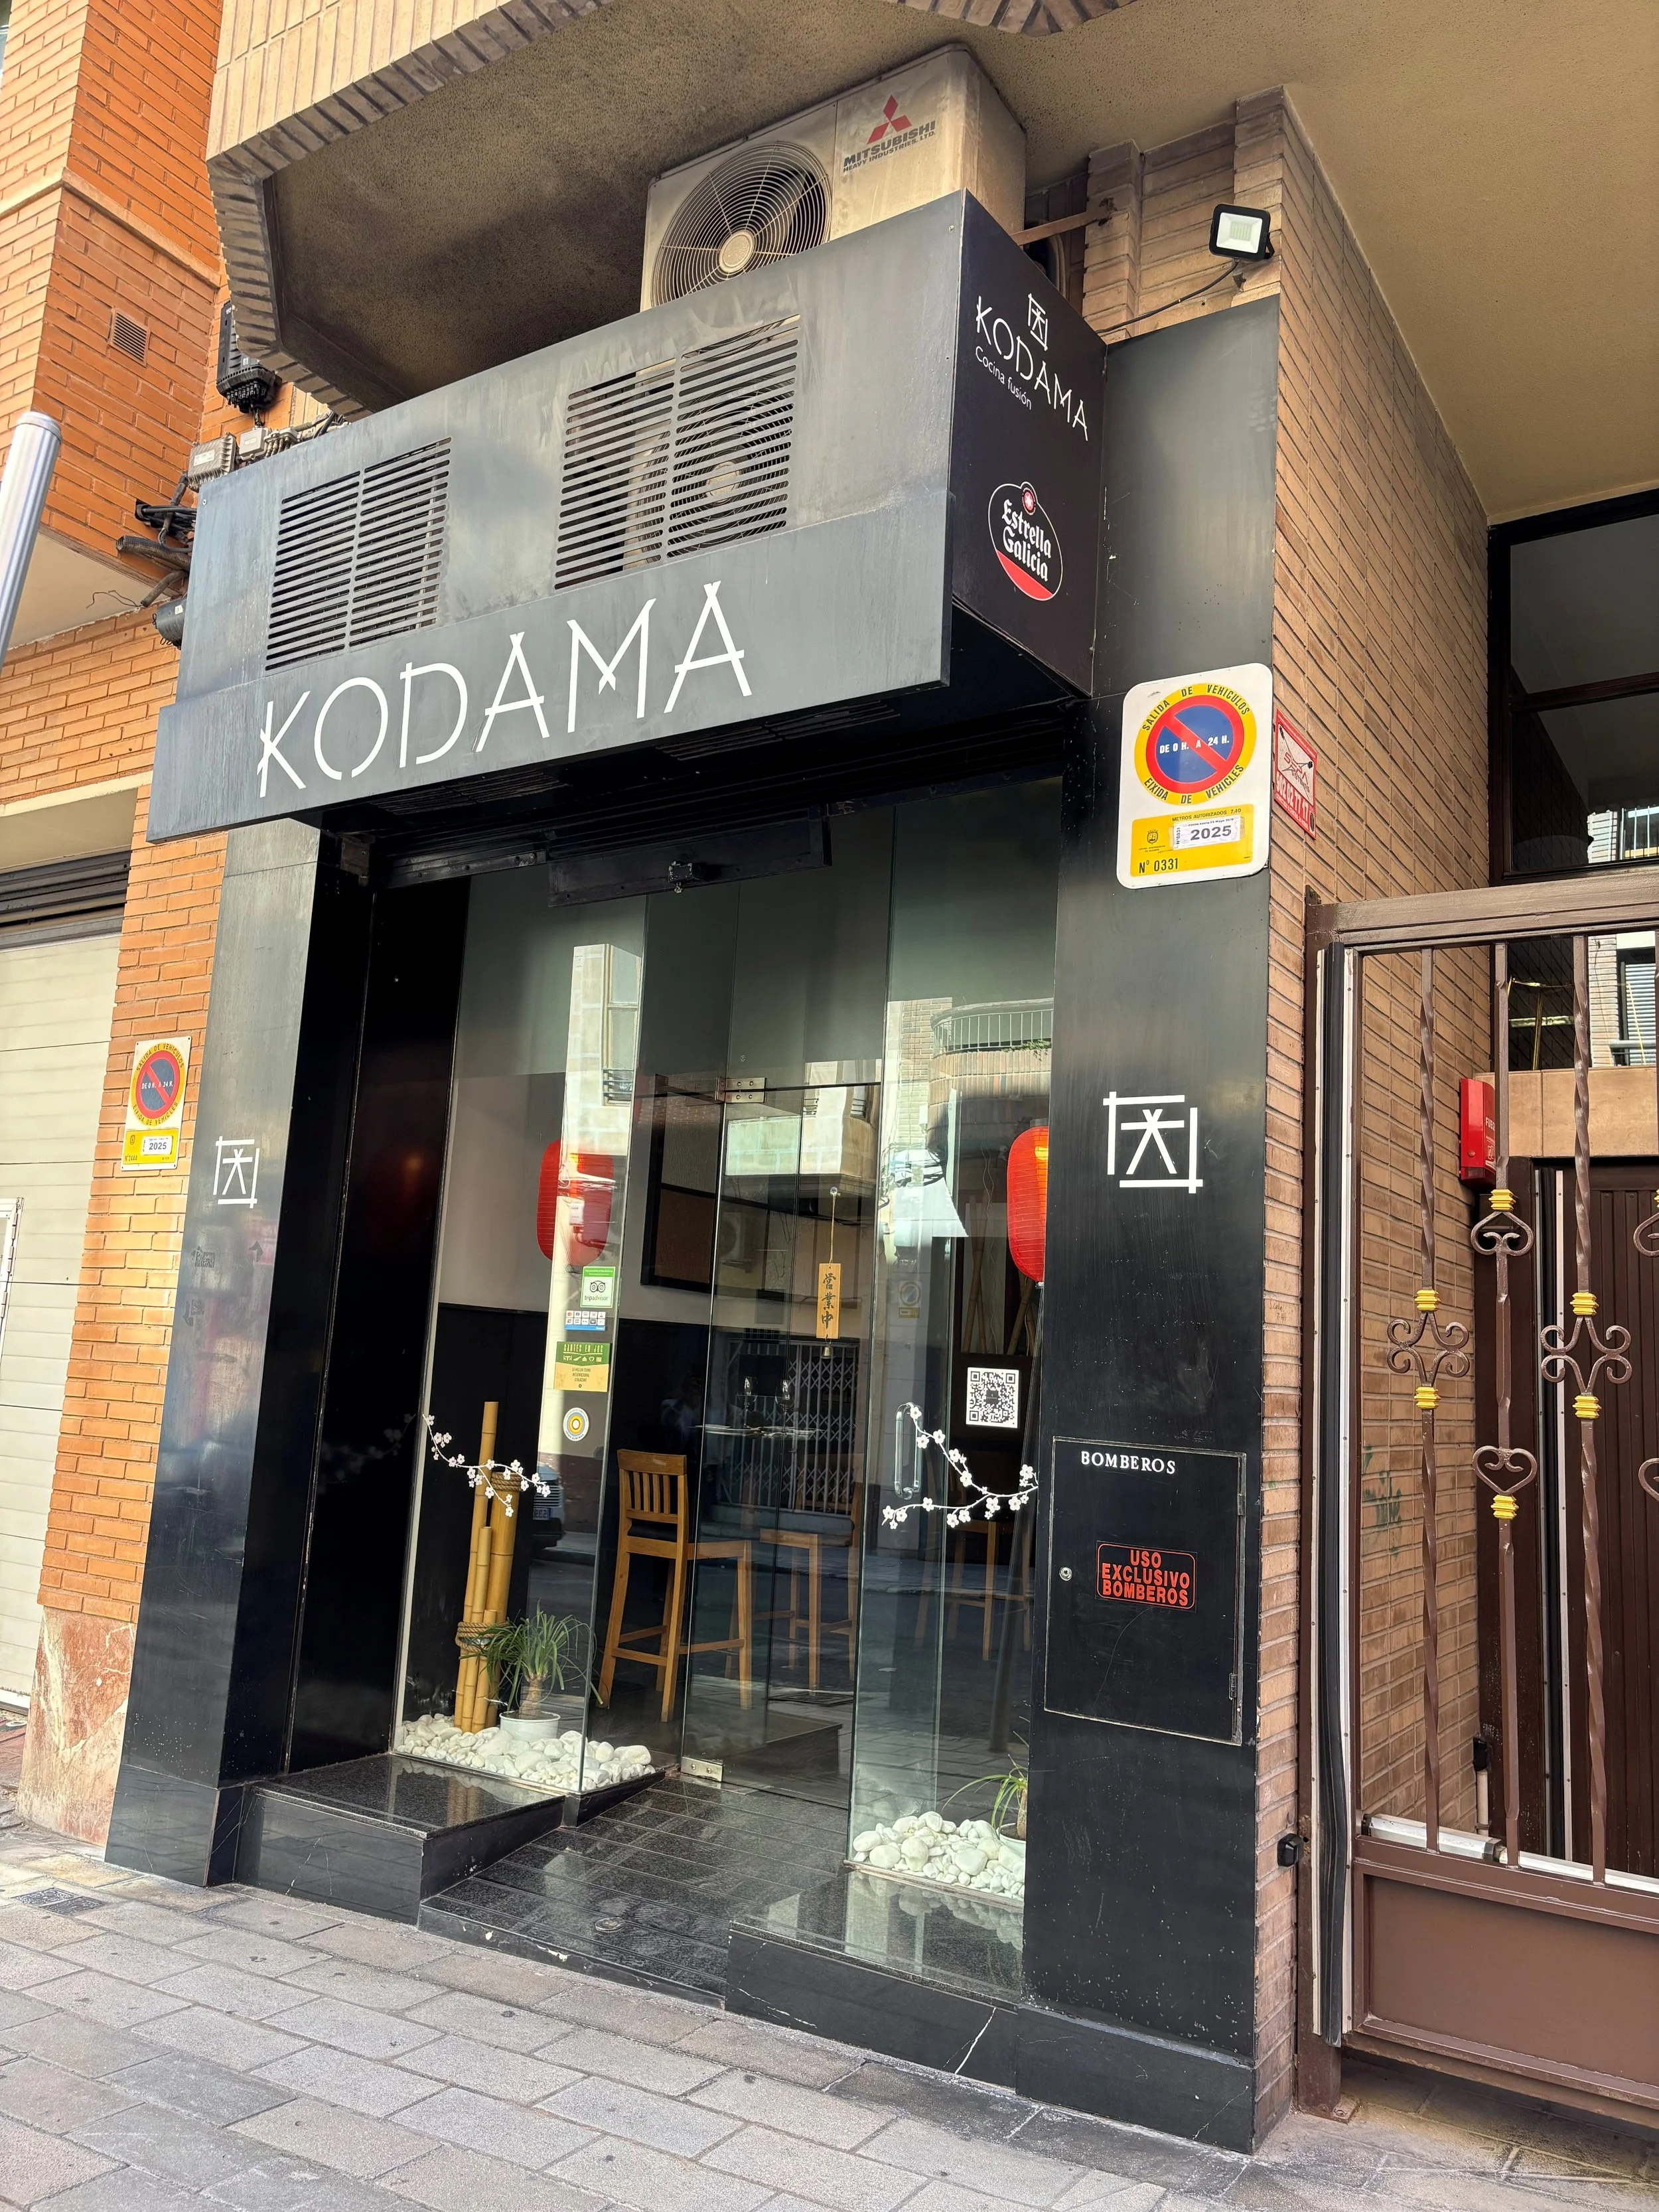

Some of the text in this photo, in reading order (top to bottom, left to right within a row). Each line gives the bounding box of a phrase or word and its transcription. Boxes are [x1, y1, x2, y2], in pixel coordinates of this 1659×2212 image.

[843, 120, 936, 167] MITSUBISHI
[843, 131, 936, 173] HEAVY INDUSTRIES, LTD.
[975, 295, 1089, 441] KODAMA
[975, 346, 1033, 410] Cocina fusión
[1001, 498, 1052, 558] Estrella
[1002, 526, 1048, 582] Galicia
[257, 579, 753, 798] KODAMA
[1142, 684, 1250, 731] SALIDA DE VEHICULOS
[1159, 744, 1170, 754] DE
[1181, 741, 1189, 751] H.
[1195, 739, 1202, 749] A
[1208, 736, 1218, 747] 24
[1221, 735, 1230, 744] H.
[1143, 764, 1245, 804] EIXIDA DE VEHICLES
[1193, 810, 1228, 819] AUTORIZADOS
[1190, 825, 1232, 841] 2025
[1139, 857, 1179, 874] Nº 0331
[136, 1049, 153, 1071] SALIDA
[163, 1043, 184, 1068] VEHICULOS
[132, 1104, 145, 1122] EIXIDA
[155, 1102, 178, 1126] VEHICLES
[149, 1142, 167, 1151] 2025
[1081, 1451, 1176, 1475] BOMBEROS
[1130, 1549, 1162, 1569] USO
[1102, 1562, 1190, 1589] EXCLUSIVO
[1102, 1580, 1189, 1607] BOMBEROS
